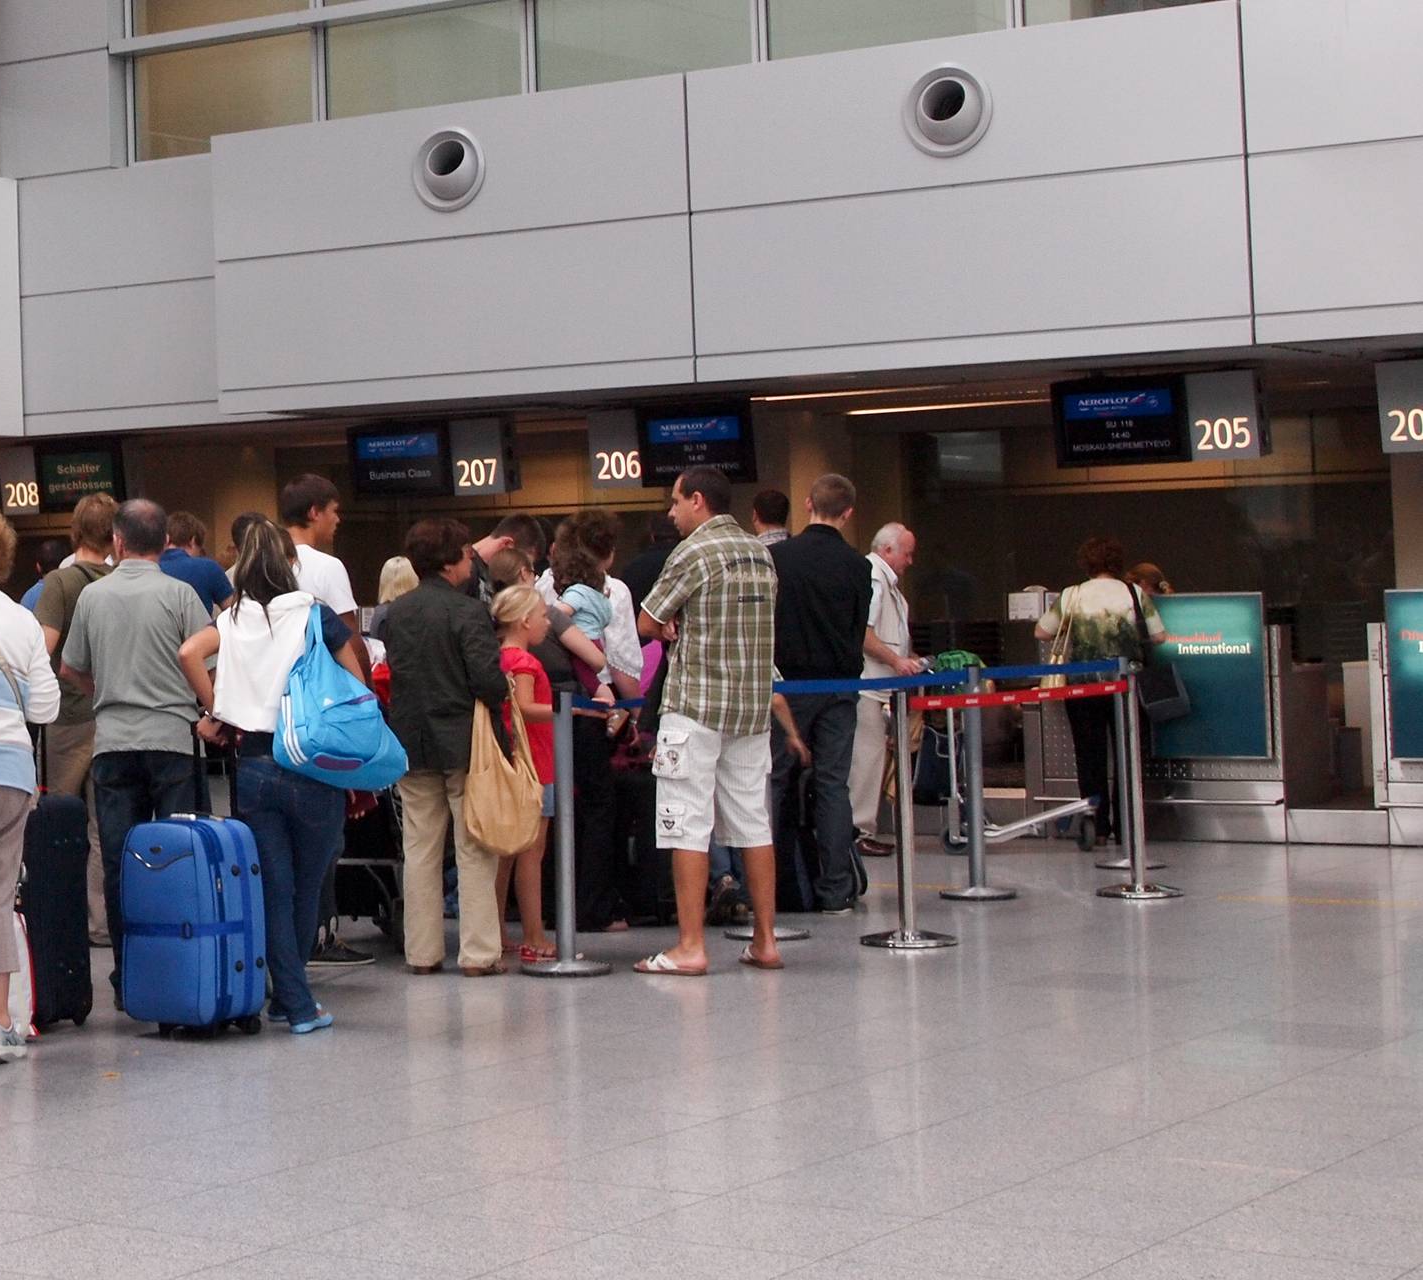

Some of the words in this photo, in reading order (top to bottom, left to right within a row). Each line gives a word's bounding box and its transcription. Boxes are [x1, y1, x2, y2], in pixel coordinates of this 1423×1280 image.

[1078, 397, 1130, 407] AEROFLOT
[1194, 416, 1251, 451] 205
[56, 462, 101, 475] Schalter
[456, 458, 497, 487] 207
[595, 451, 642, 481] 206
[4, 481, 40, 508] 208
[48, 480, 113, 494] geschlossen
[1177, 643, 1251, 655] International
